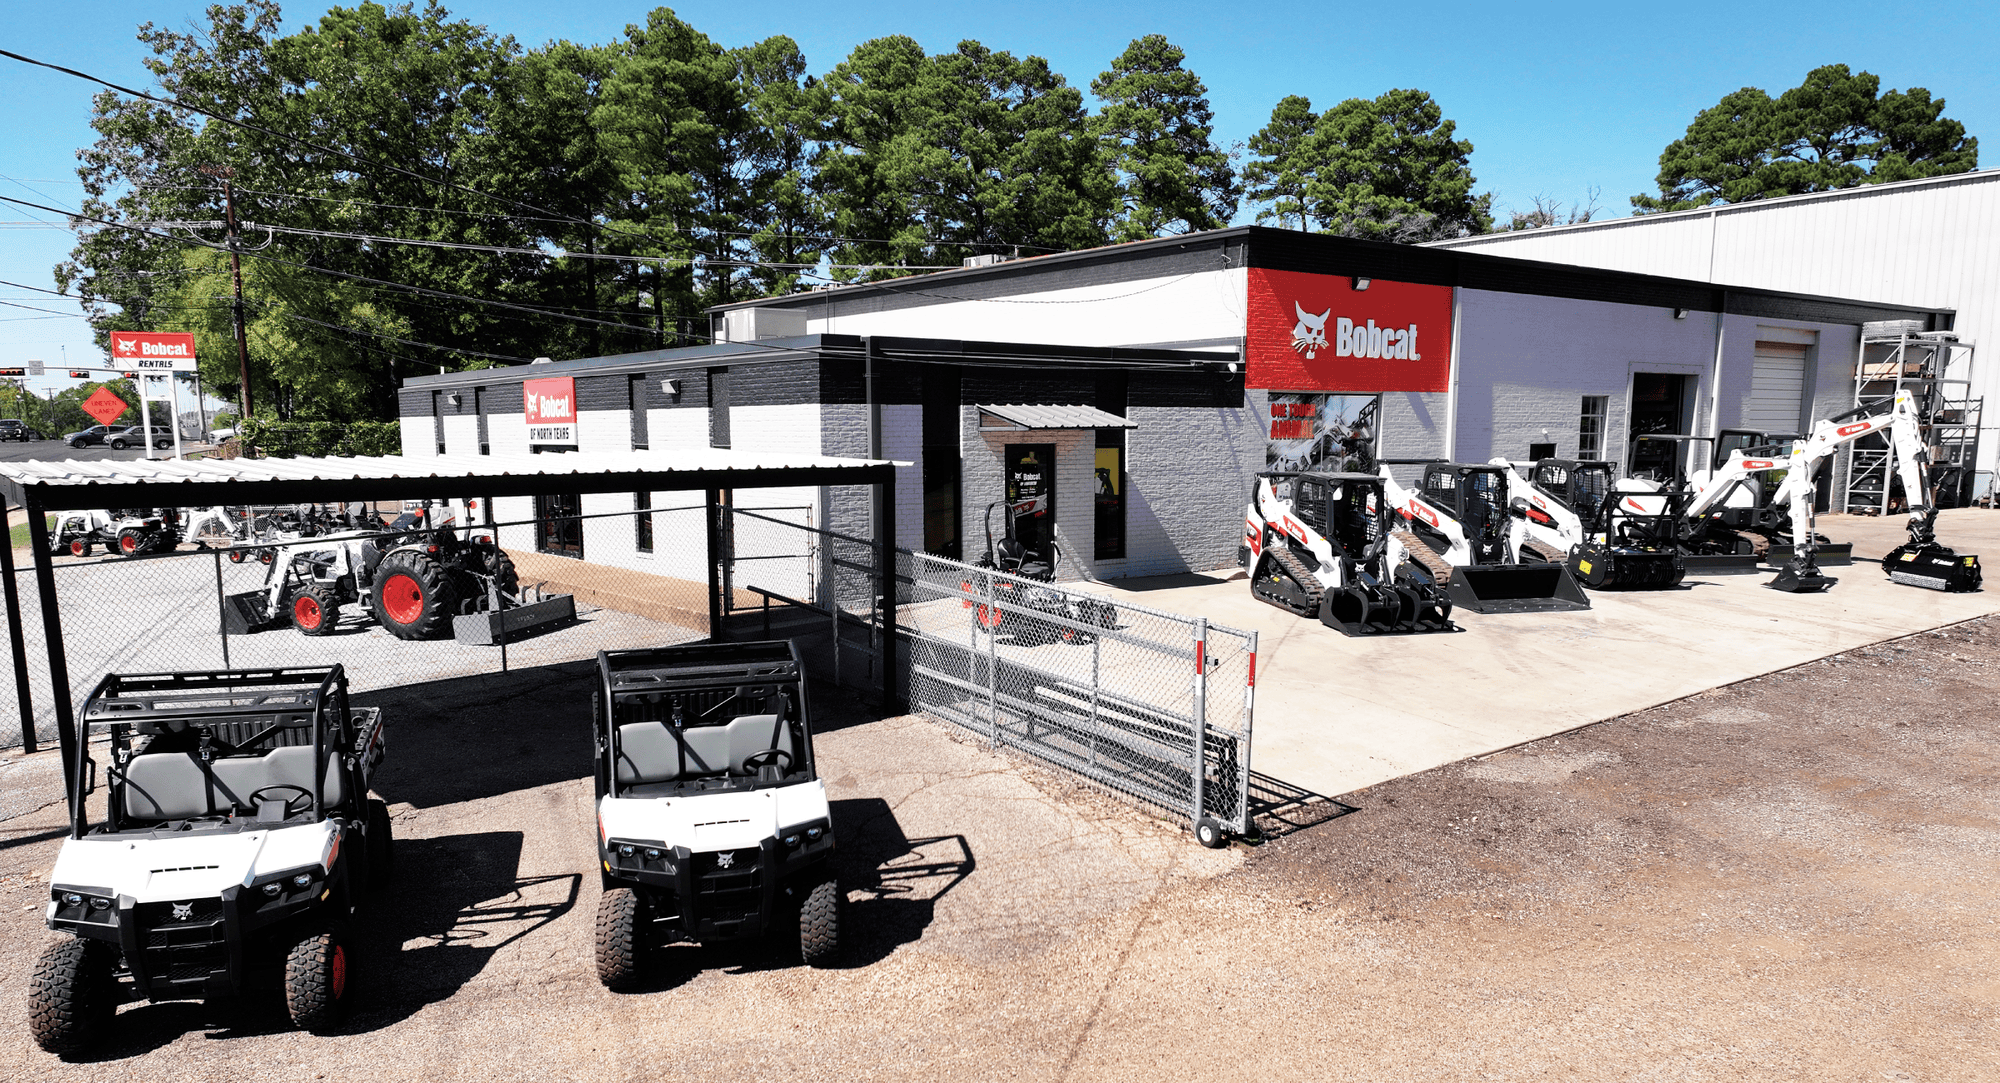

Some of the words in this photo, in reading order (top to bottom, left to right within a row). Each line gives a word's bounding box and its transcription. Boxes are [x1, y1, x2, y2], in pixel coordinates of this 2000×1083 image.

[1336, 316, 1417, 361] Bobcat
[141, 342, 188, 356] Bobcat
[138, 360, 173, 368] RENTALS
[540, 395, 569, 418] Bobcat
[1271, 403, 1286, 417] ONE
[1289, 403, 1316, 417] TOUGH
[530, 427, 536, 440] OF
[537, 427, 552, 440] NORTH
[554, 426, 570, 440] TEXAS
[1270, 419, 1314, 439] ANIMAL
